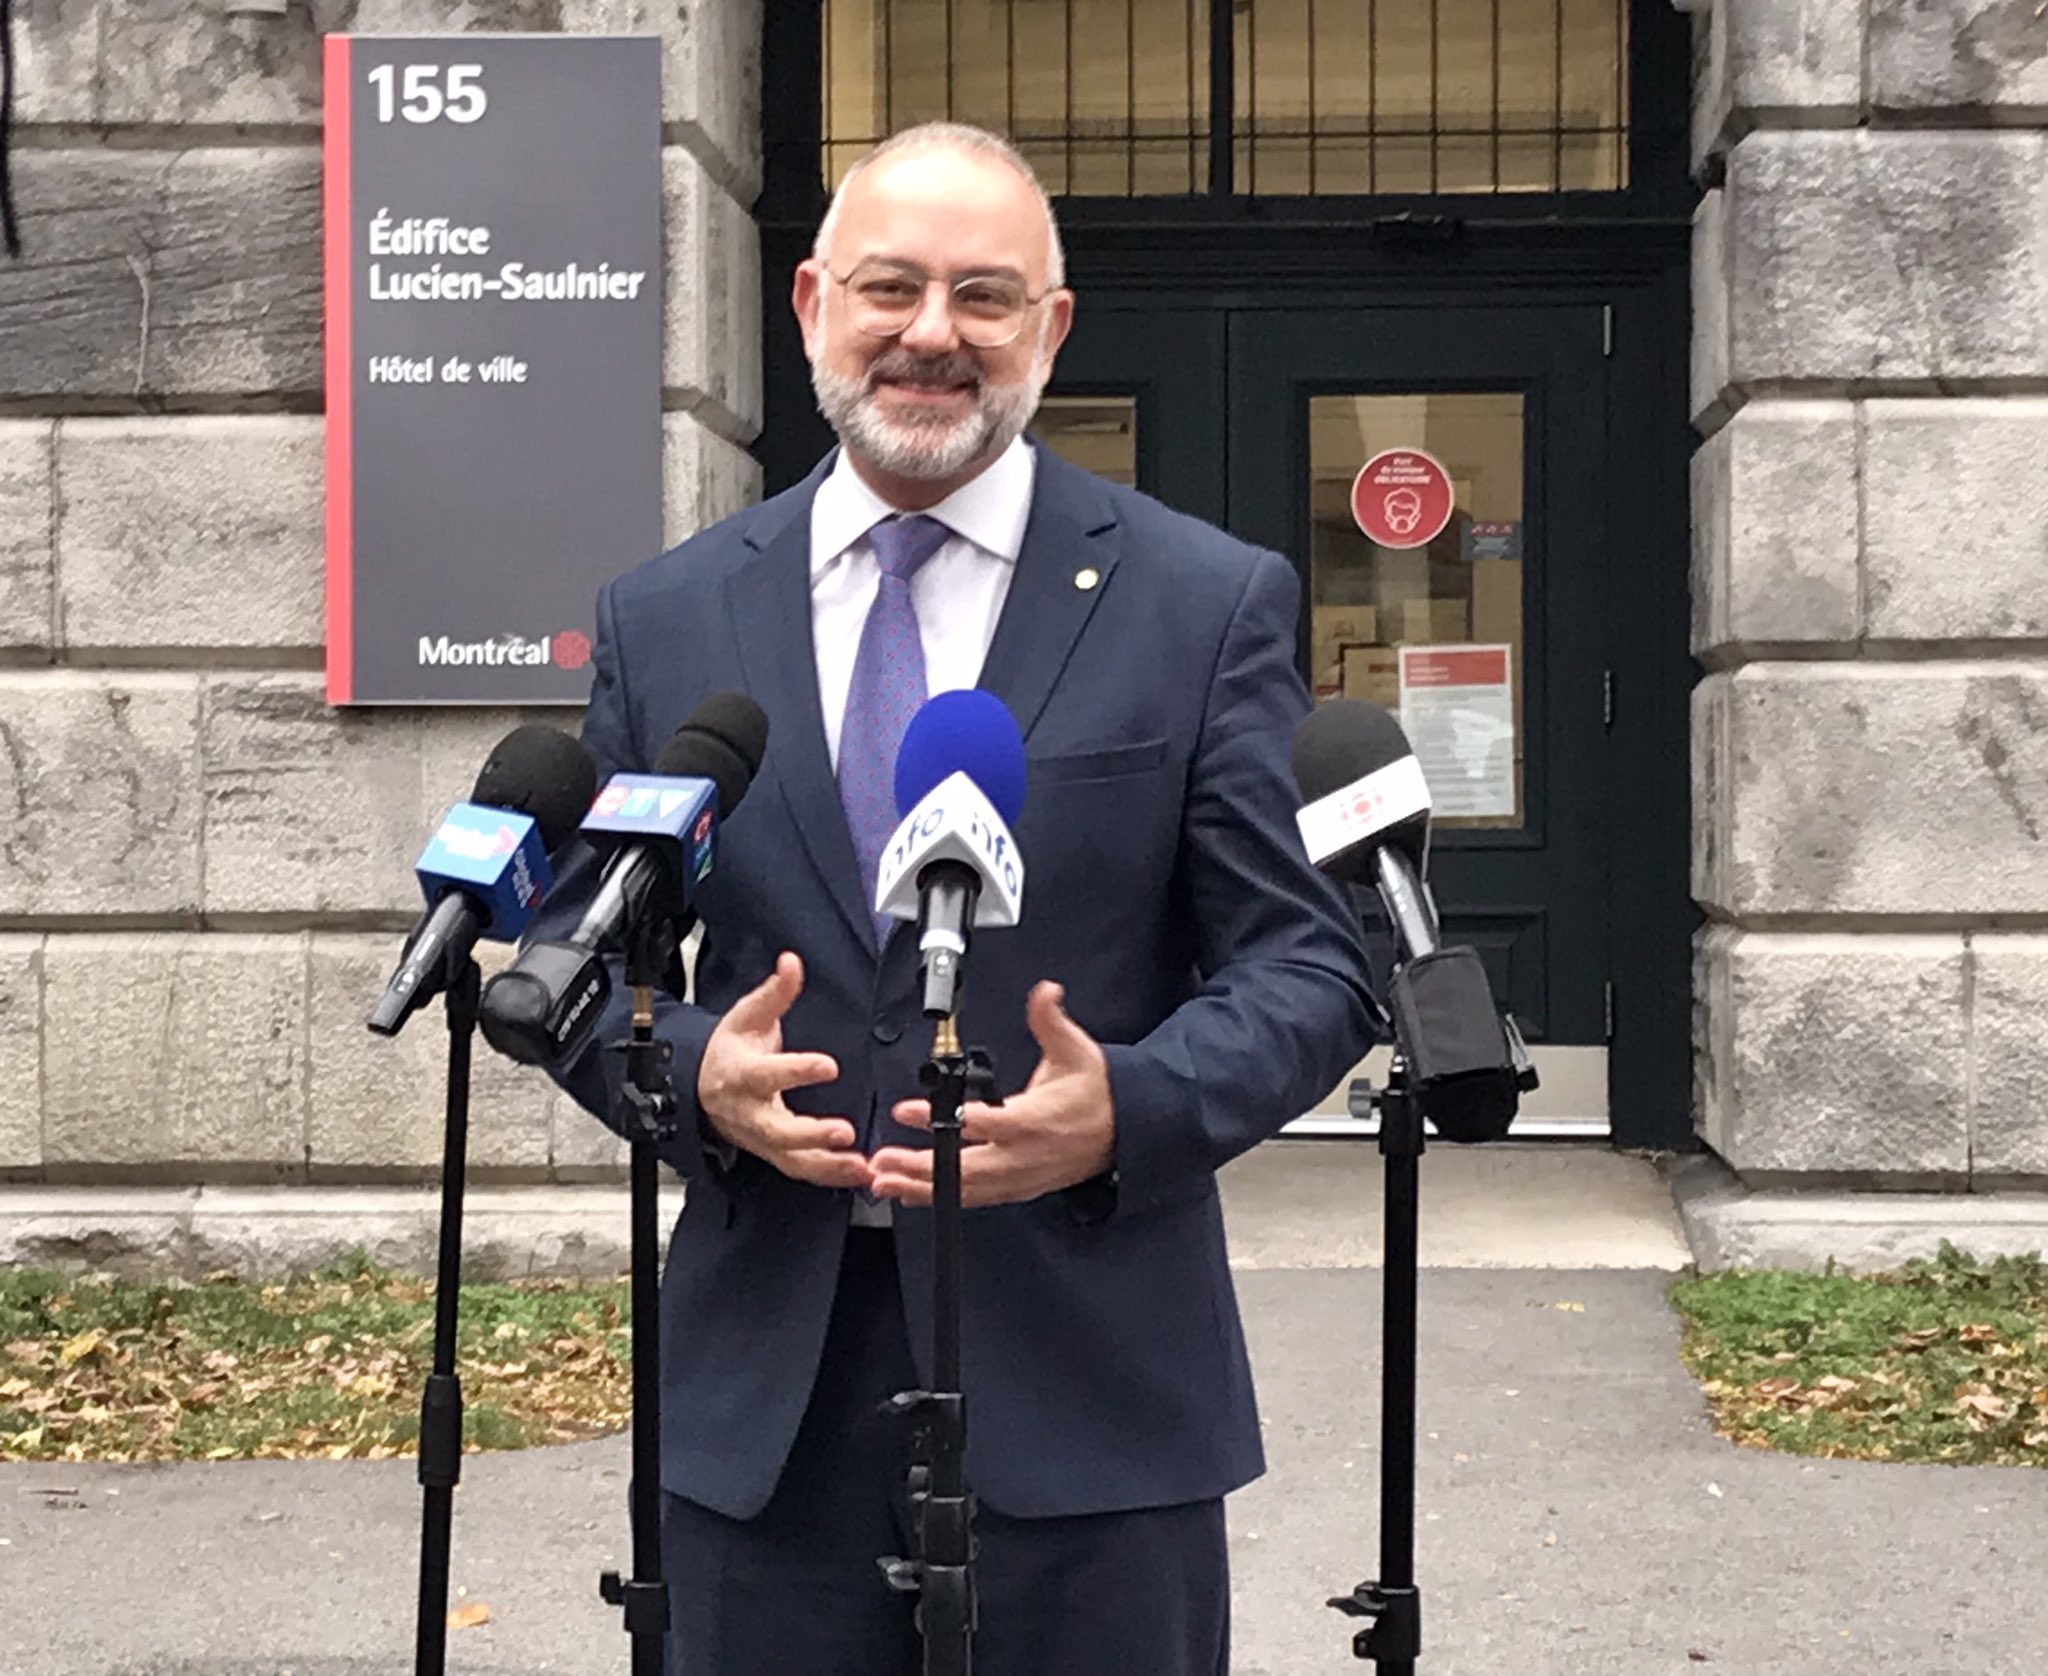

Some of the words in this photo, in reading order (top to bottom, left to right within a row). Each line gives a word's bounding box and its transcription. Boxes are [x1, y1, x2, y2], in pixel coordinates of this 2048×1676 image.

[368, 64, 487, 123] 155
[369, 207, 490, 255] Édifice
[369, 263, 645, 300] Lucien-Saulnier
[369, 355, 433, 382] Hôtel
[441, 356, 471, 382] de
[478, 356, 528, 382] ville
[419, 632, 550, 666] Montréal
[591, 785, 696, 819] CTV
